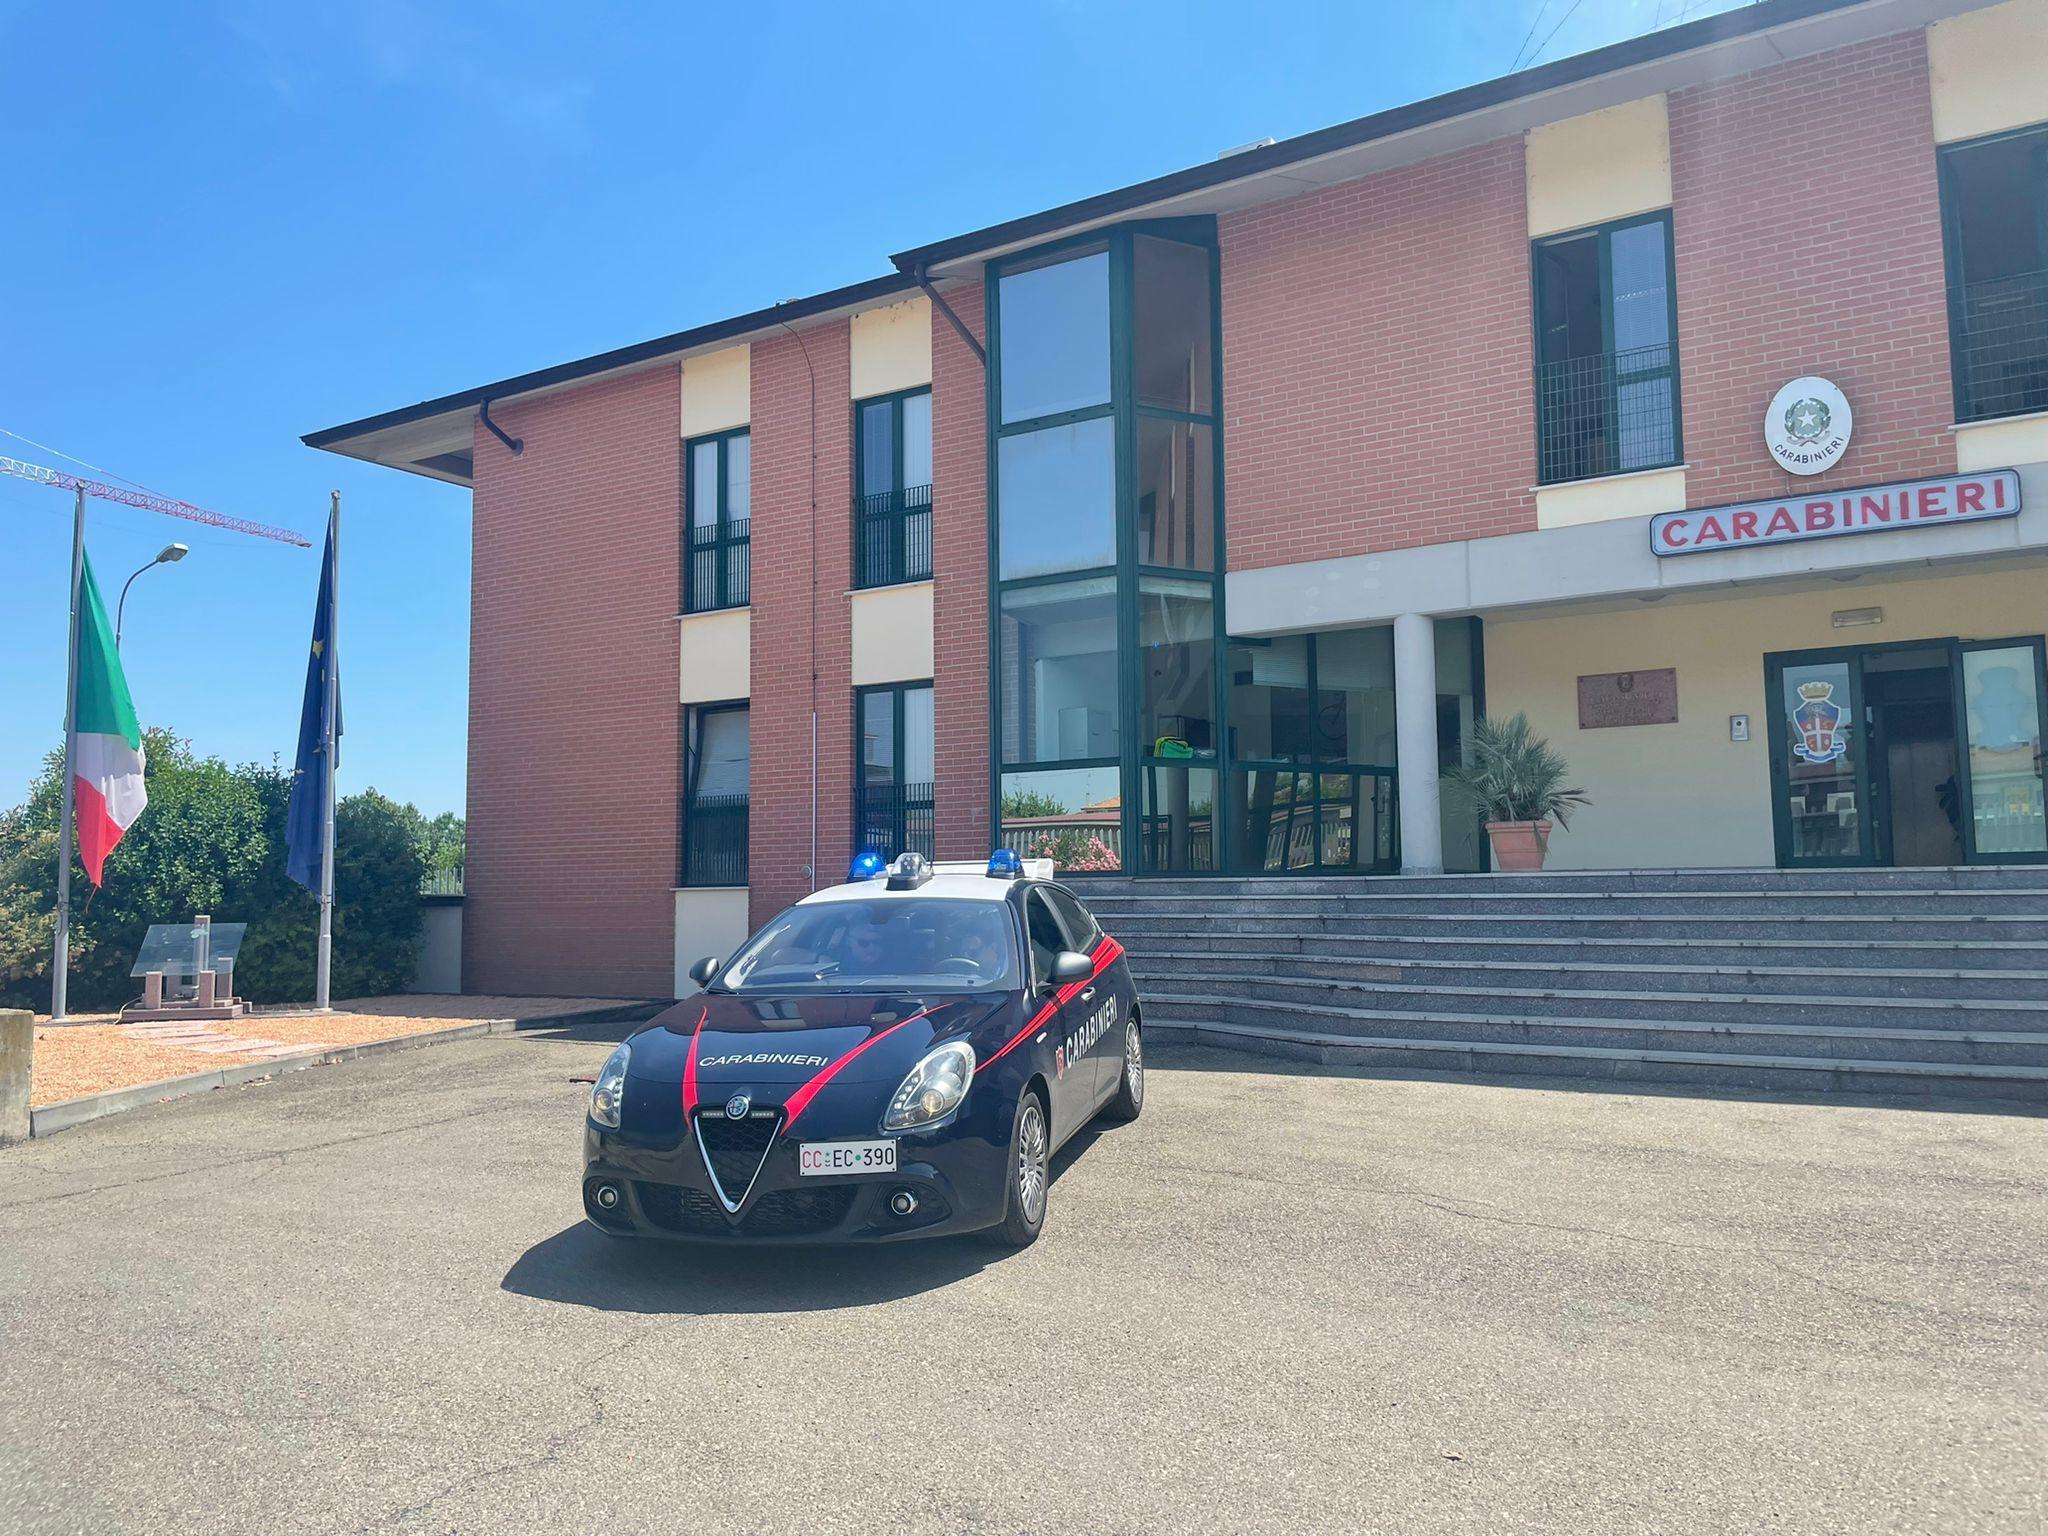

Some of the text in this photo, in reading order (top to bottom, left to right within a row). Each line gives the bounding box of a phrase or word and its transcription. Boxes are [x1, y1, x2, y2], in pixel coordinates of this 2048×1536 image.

[1774, 436, 1844, 464] CARABINIERI
[1661, 479, 2006, 548] CARABINIERI
[1066, 993, 1118, 1069] CARABINIERI
[699, 1053, 828, 1067] CARABINIERI
[802, 1147, 894, 1169] CC EC 390
